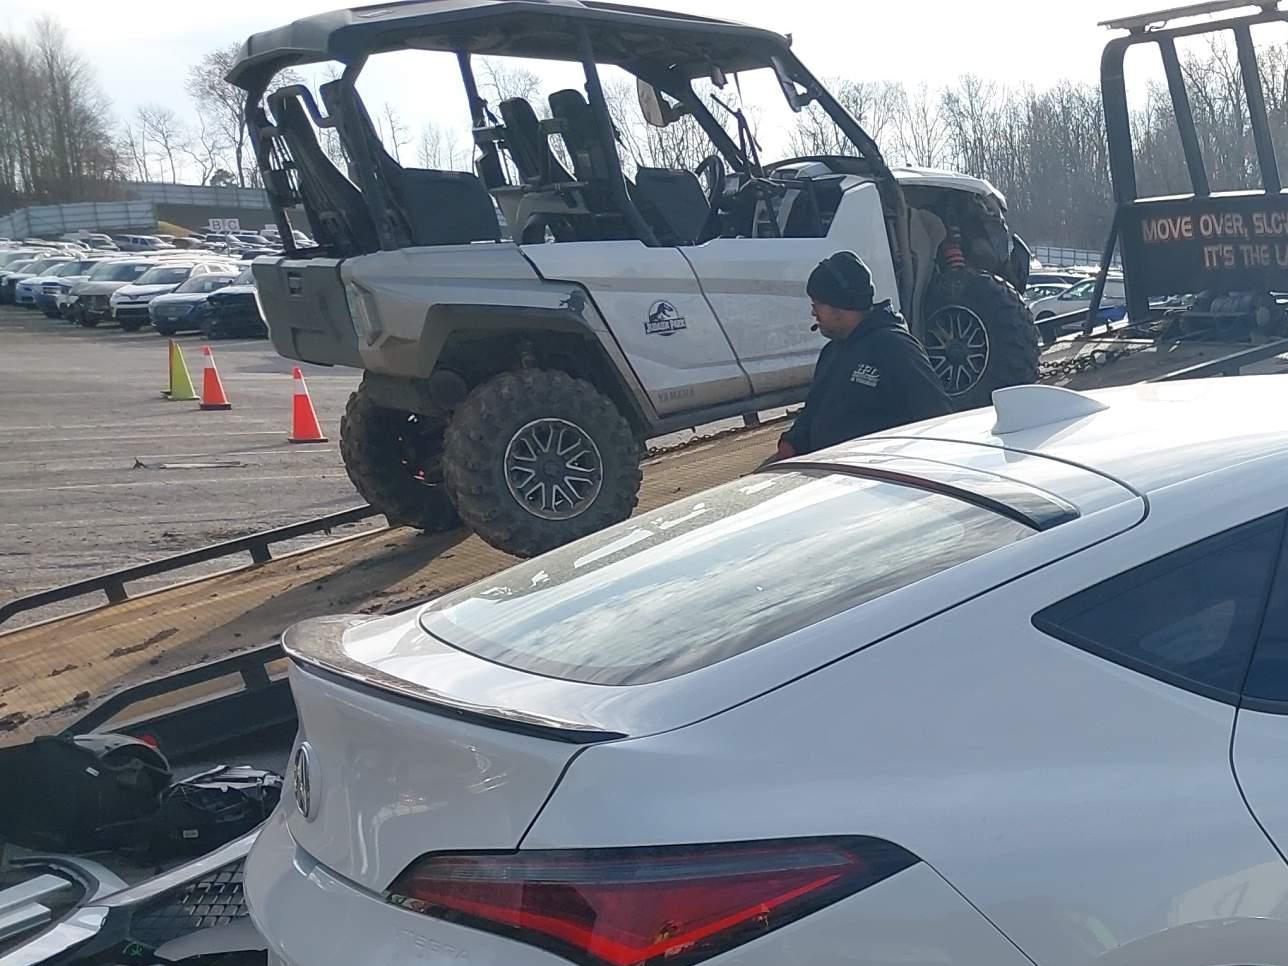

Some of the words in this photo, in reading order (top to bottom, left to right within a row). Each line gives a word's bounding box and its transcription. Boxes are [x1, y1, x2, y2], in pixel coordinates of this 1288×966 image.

[1142, 215, 1193, 241] MOVE
[1200, 212, 1249, 237] OVER,
[1204, 244, 1235, 268] IT'S
[1239, 243, 1270, 267] THE
